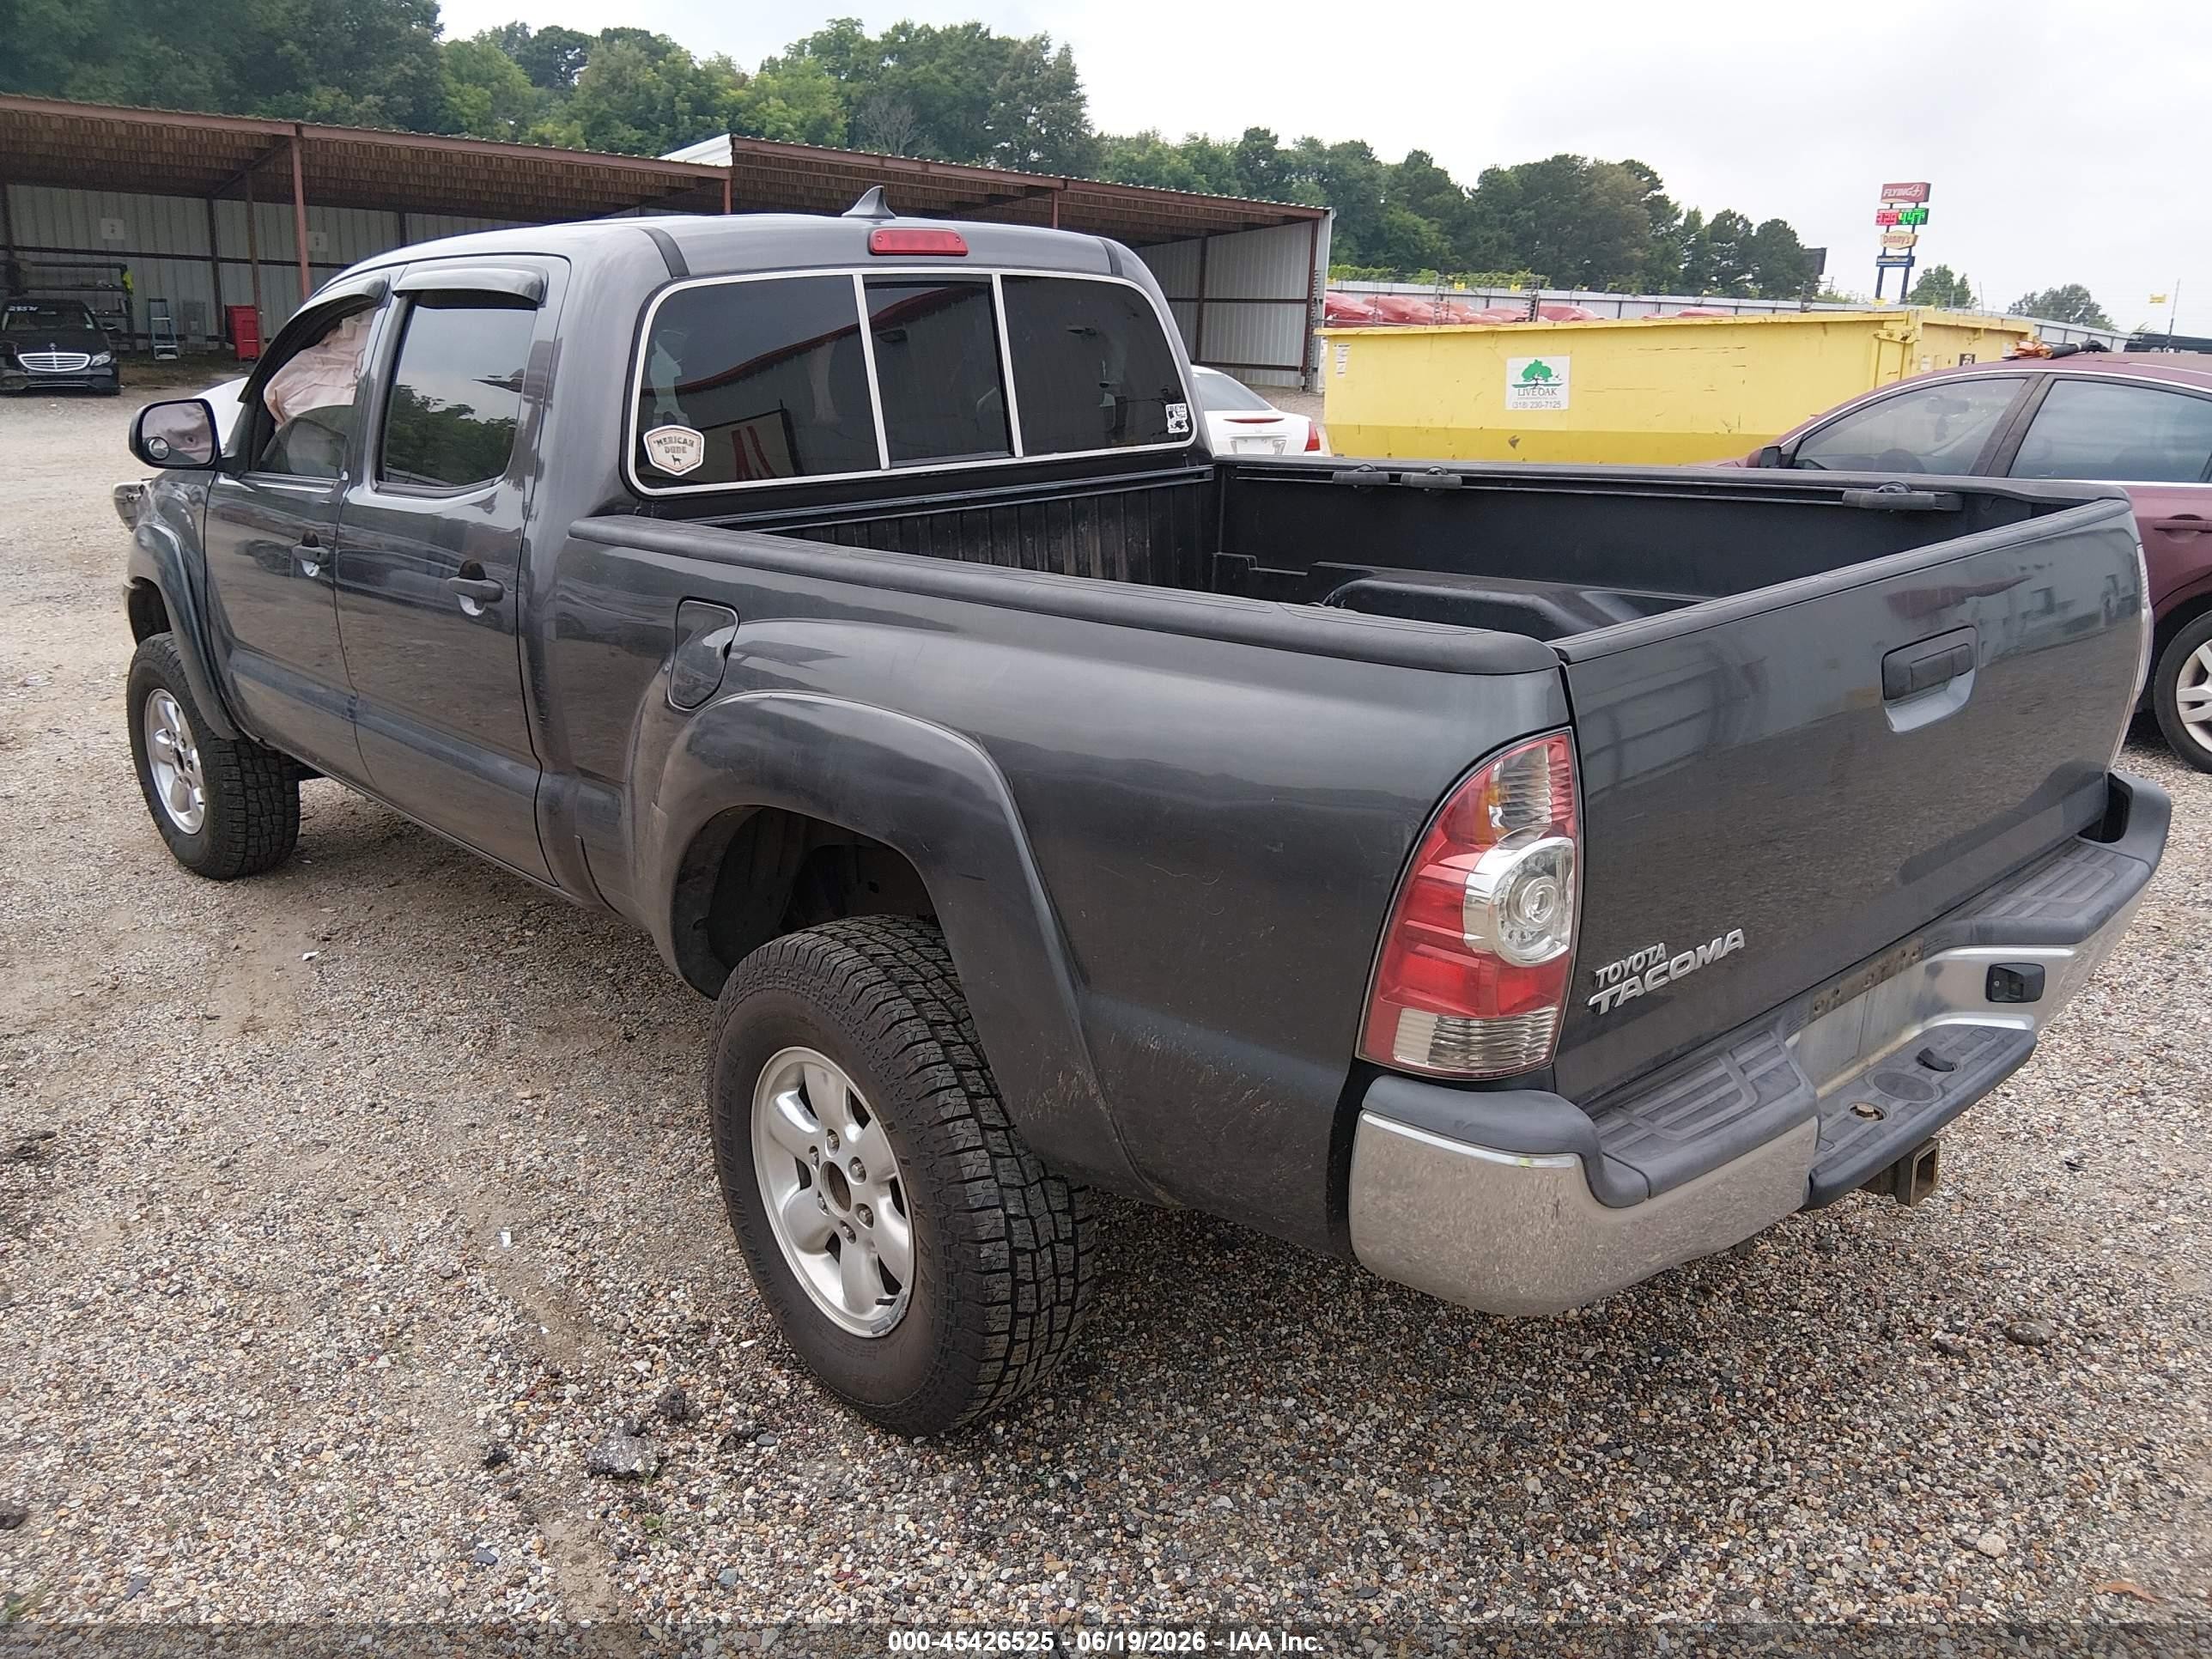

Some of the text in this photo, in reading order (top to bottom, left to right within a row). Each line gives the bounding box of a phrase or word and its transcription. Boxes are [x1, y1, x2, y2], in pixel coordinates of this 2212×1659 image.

[664, 446, 688, 454] DUDE
[1588, 928, 1746, 1016] TACOMA
[1595, 942, 1667, 988] TOYOTA
